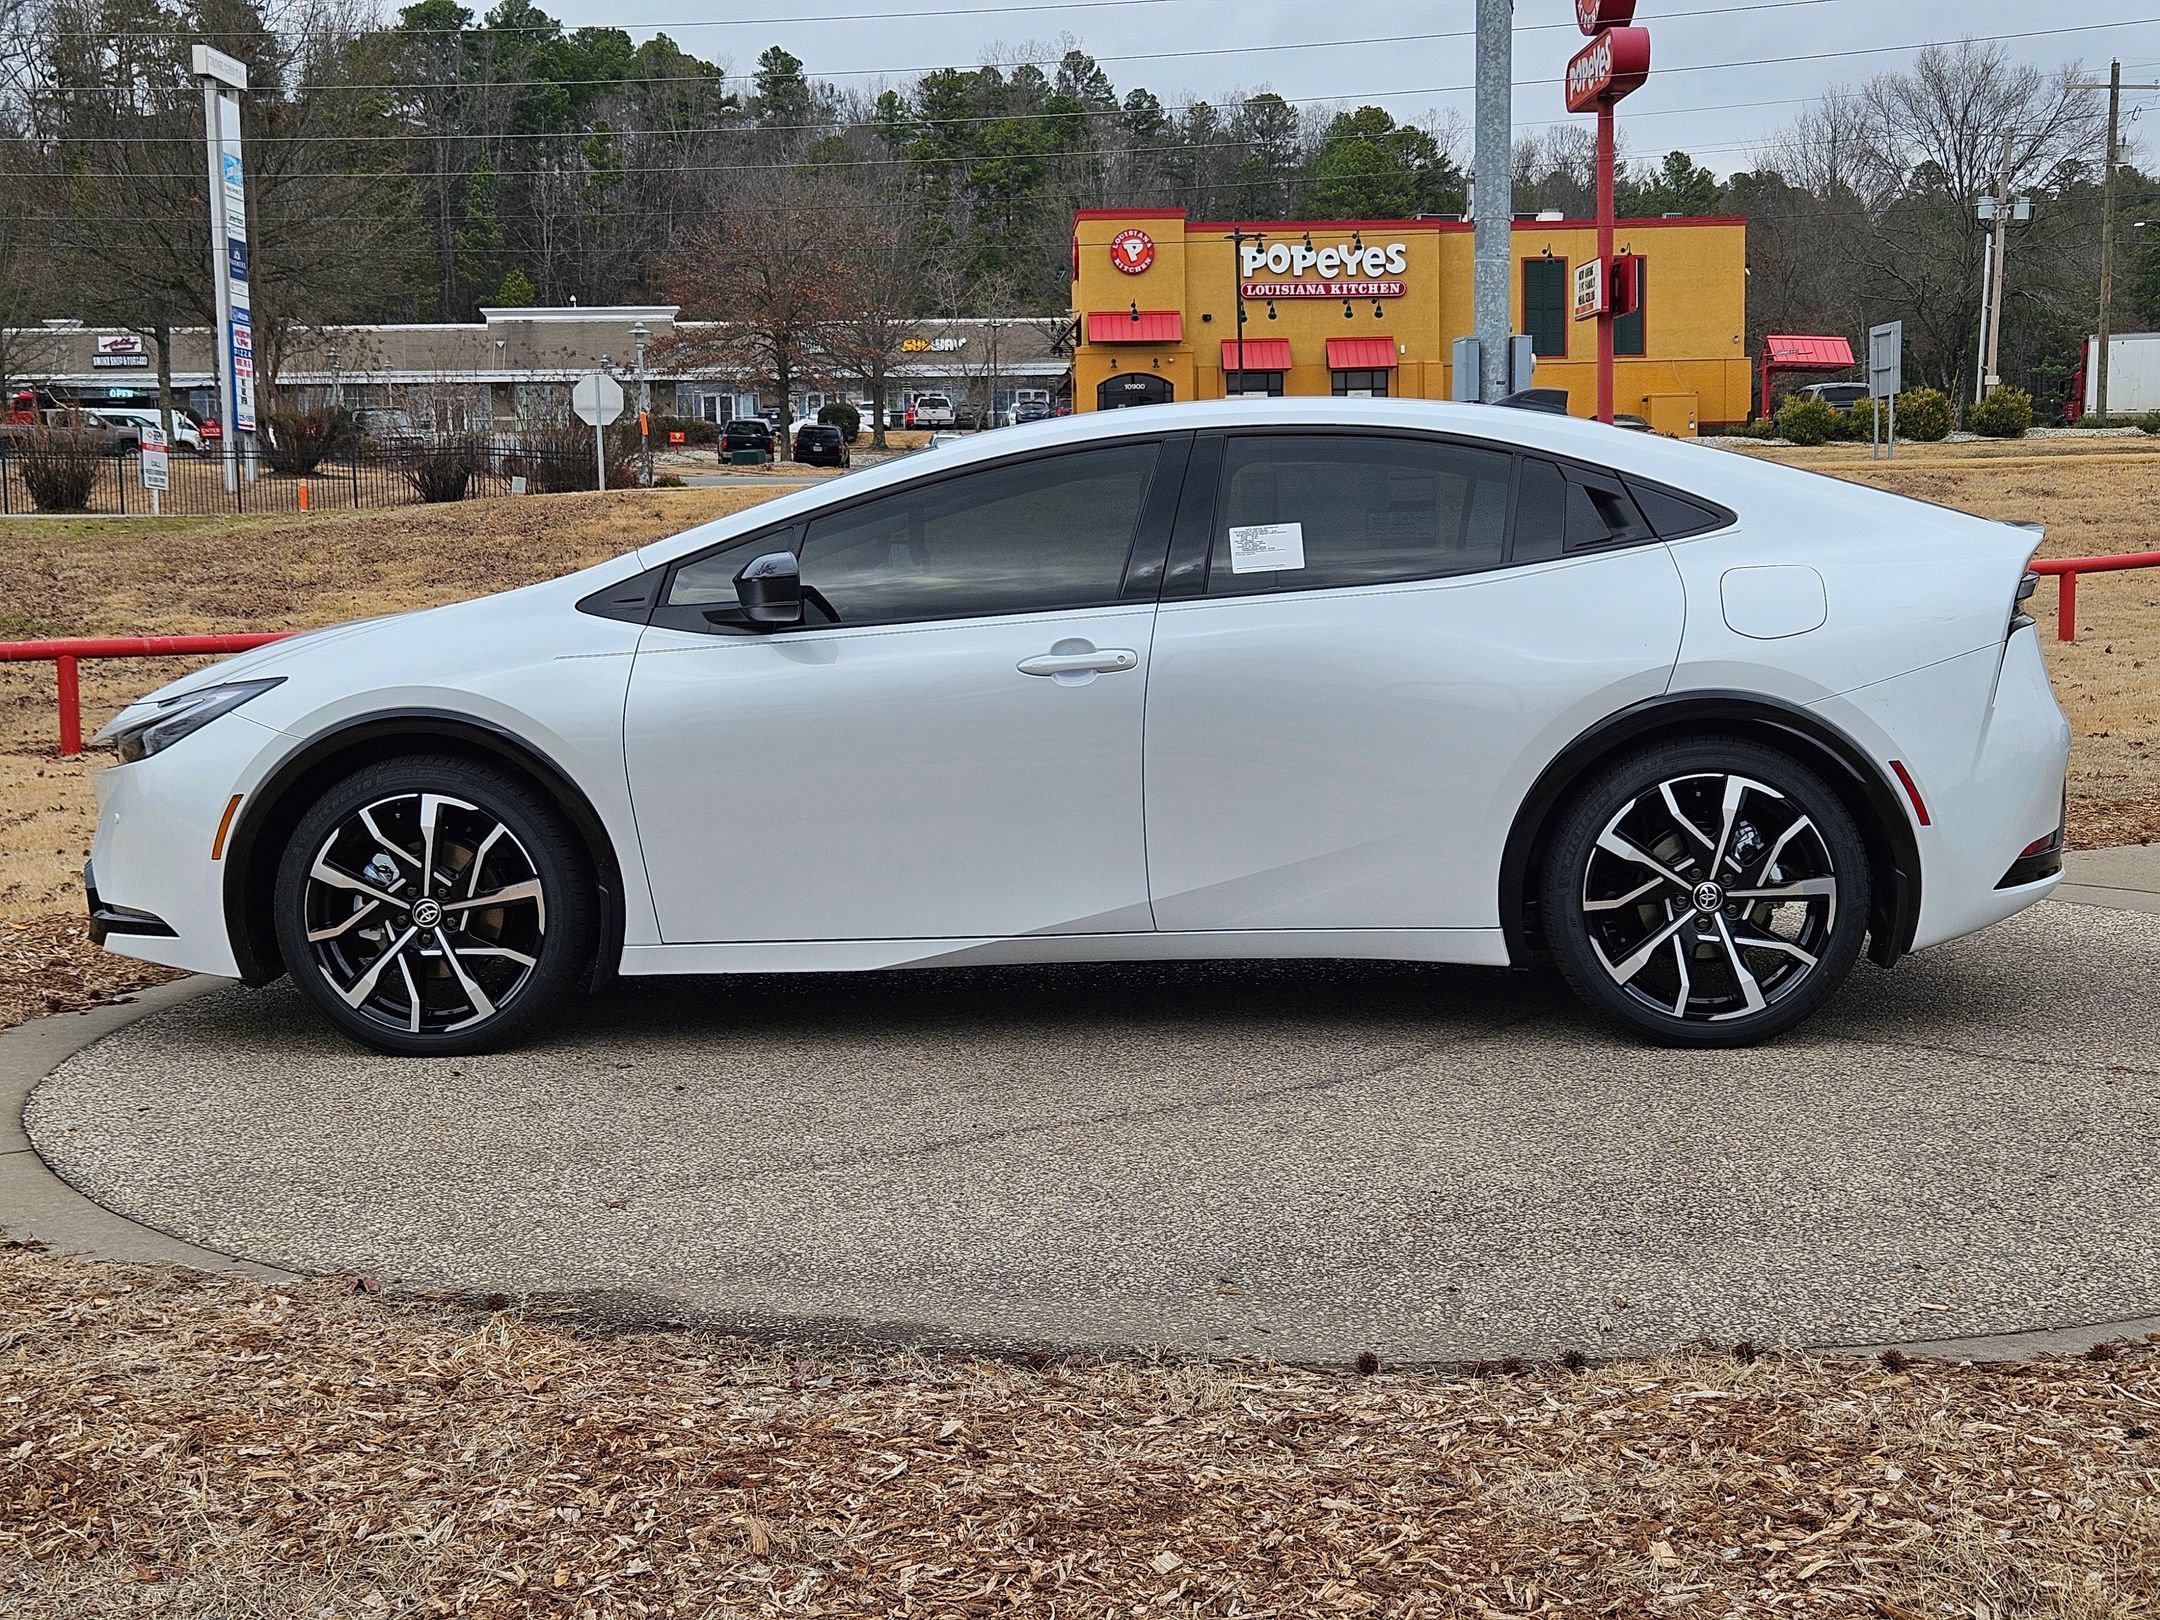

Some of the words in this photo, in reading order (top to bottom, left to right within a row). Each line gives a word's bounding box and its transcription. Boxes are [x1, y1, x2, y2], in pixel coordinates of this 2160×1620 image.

[1112, 230, 1153, 249] LOUISIANA
[1114, 257, 1152, 273] KITCHEN
[1246, 284, 1326, 296] LOUISIANA
[1330, 282, 1400, 295] KITCHEN
[109, 388, 134, 398] OPEN
